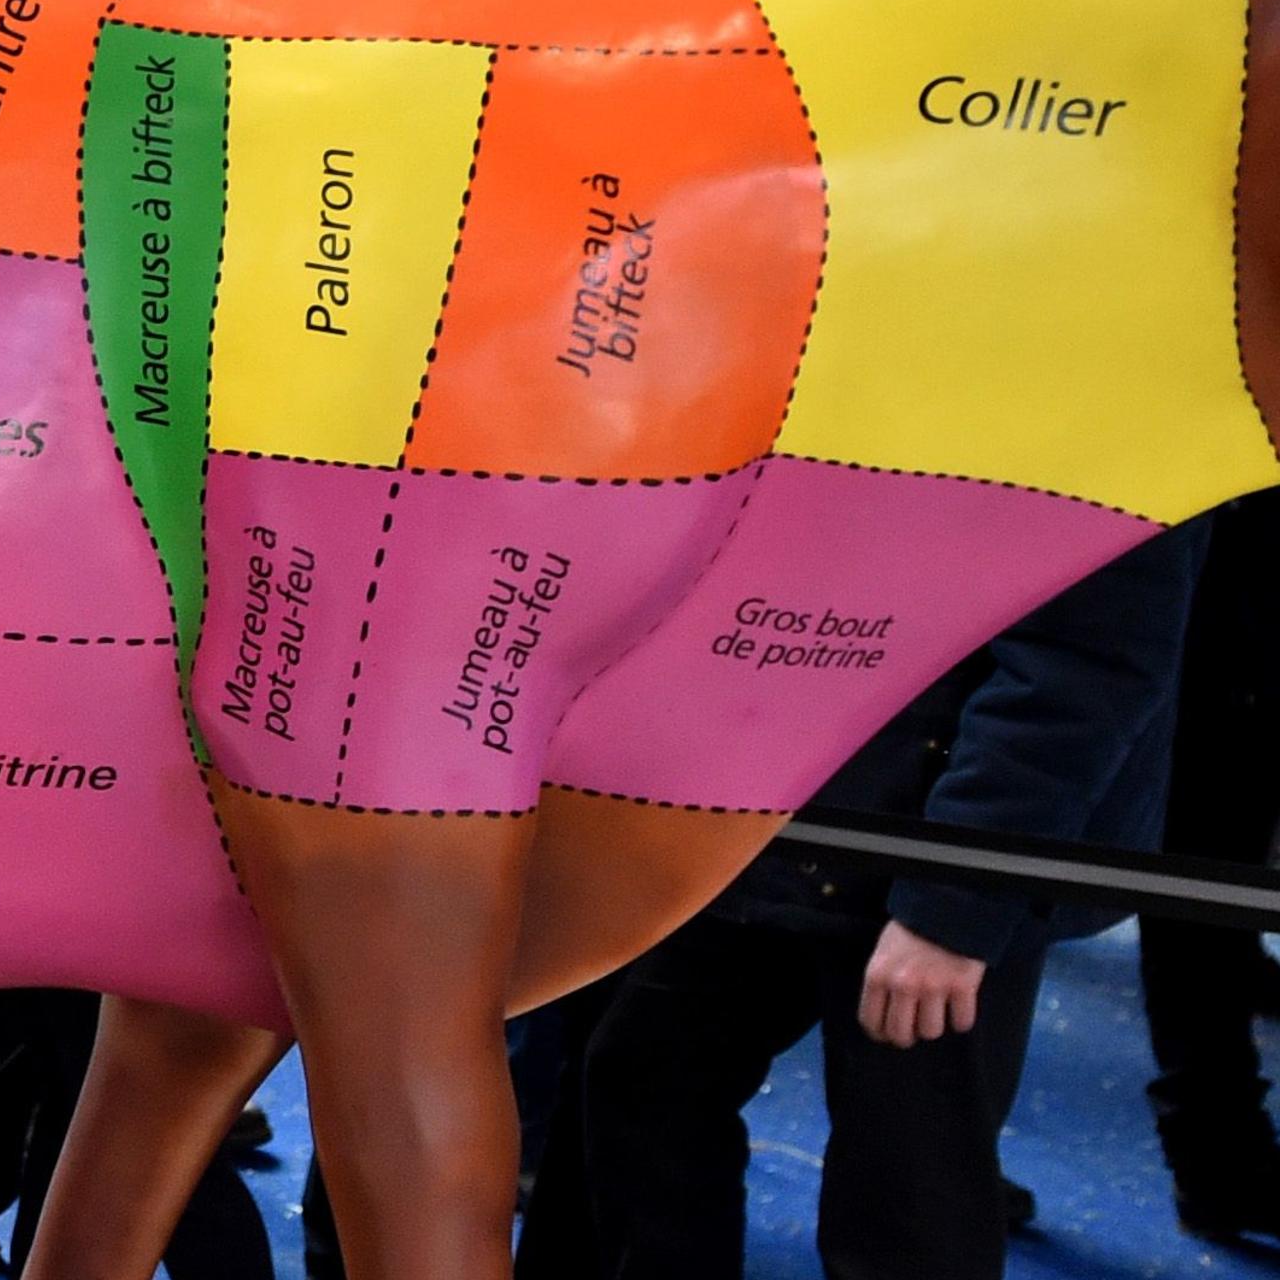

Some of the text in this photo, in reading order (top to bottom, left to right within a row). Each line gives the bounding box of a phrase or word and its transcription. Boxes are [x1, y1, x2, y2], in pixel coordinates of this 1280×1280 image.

[918, 75, 1127, 138] Collier
[131, 55, 176, 428] Macreuse à bifteck
[305, 148, 354, 337] Paleron
[556, 173, 620, 378] Jumeau à
[597, 212, 656, 362] bifteck
[221, 525, 277, 725] Macreuse à
[264, 547, 315, 742] pot-au-feu
[441, 546, 529, 731] Jumeau à
[482, 551, 571, 755] pot-au-feu
[711, 630, 885, 671] de poitrine
[735, 597, 894, 640] Gros bout
